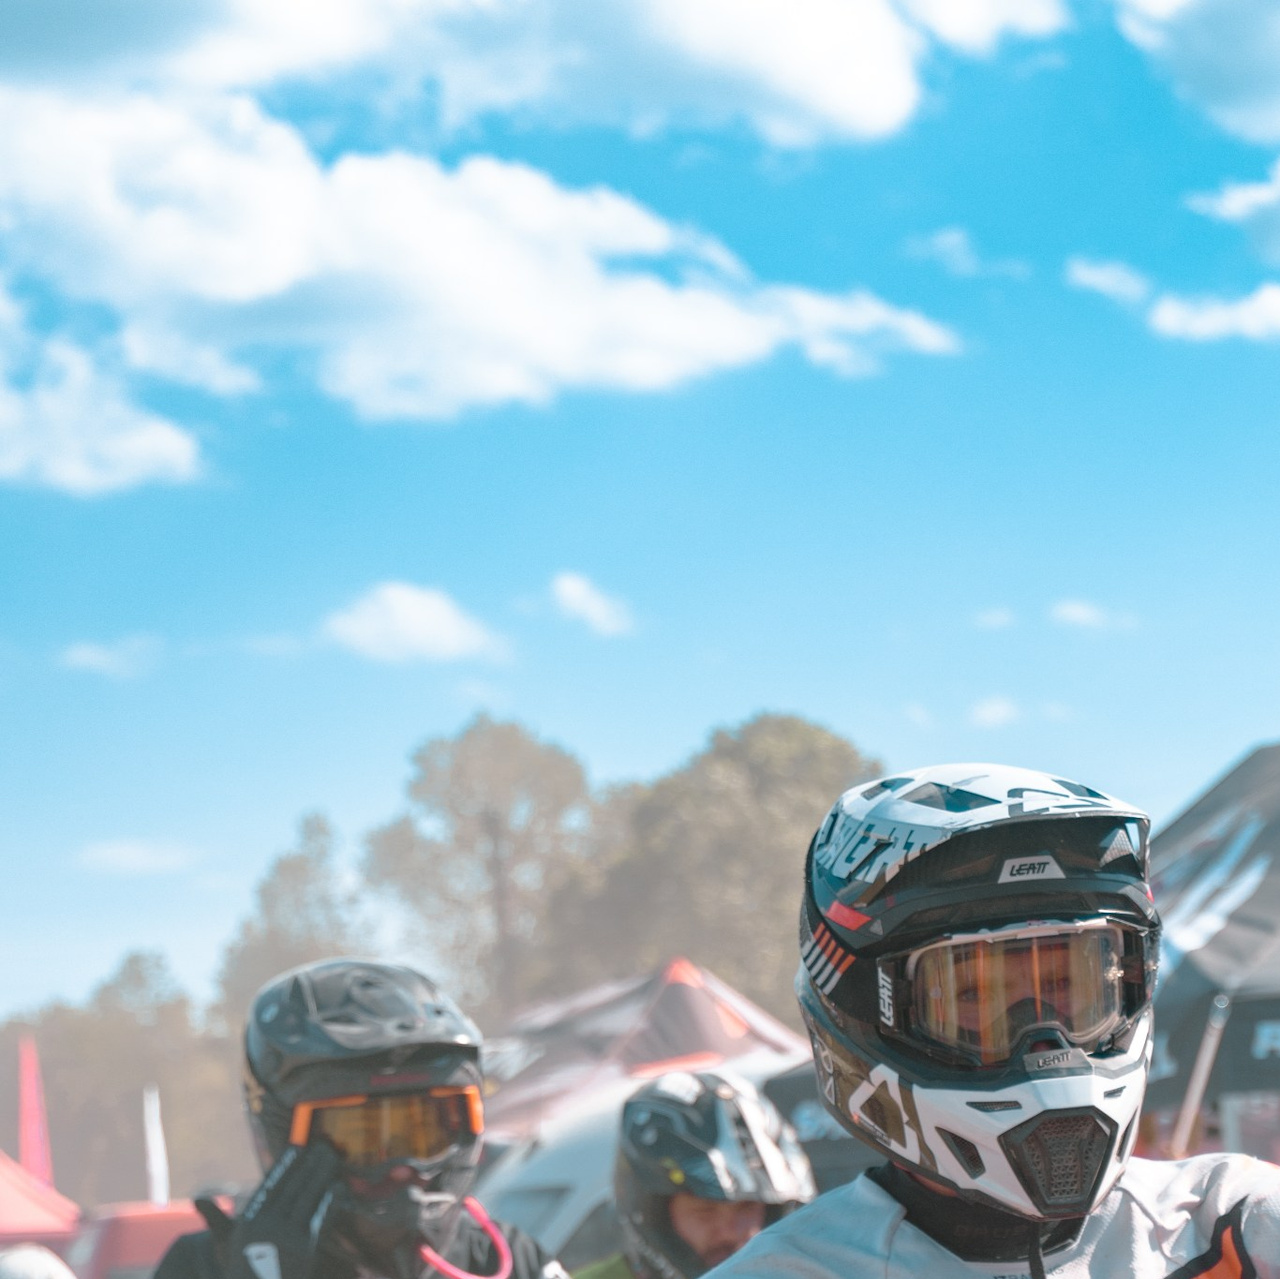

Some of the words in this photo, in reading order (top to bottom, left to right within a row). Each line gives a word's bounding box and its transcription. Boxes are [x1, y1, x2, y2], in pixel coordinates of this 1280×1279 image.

[1010, 861, 1050, 878] LEATT
[878, 966, 895, 1027] LEATT
[1037, 1051, 1072, 1069] LEATT
